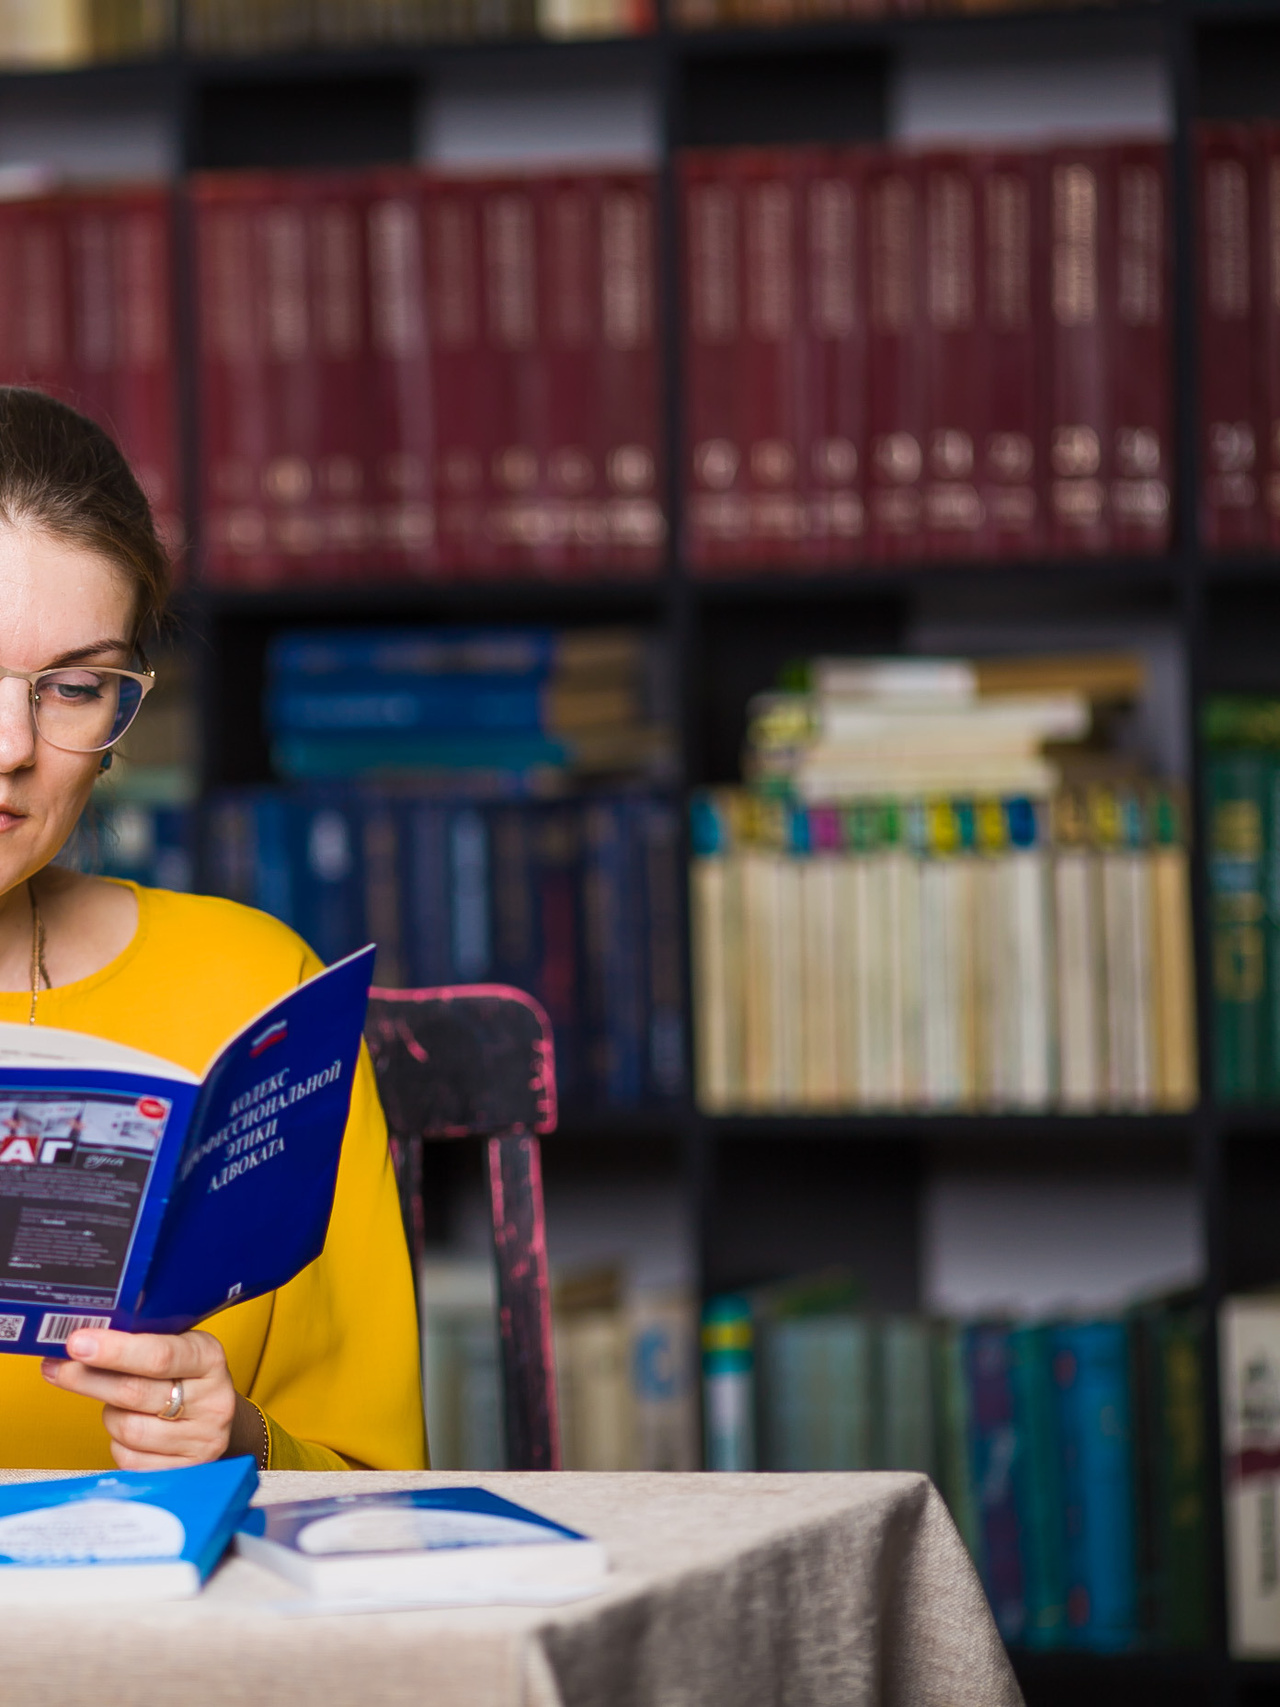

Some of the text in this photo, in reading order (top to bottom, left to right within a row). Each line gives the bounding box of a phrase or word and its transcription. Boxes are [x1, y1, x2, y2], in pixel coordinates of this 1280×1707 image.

[229, 1067, 290, 1118] КОДЕКС
[207, 1137, 286, 1194] АДВОКАТА
[224, 1118, 278, 1162] ЭТИКИ
